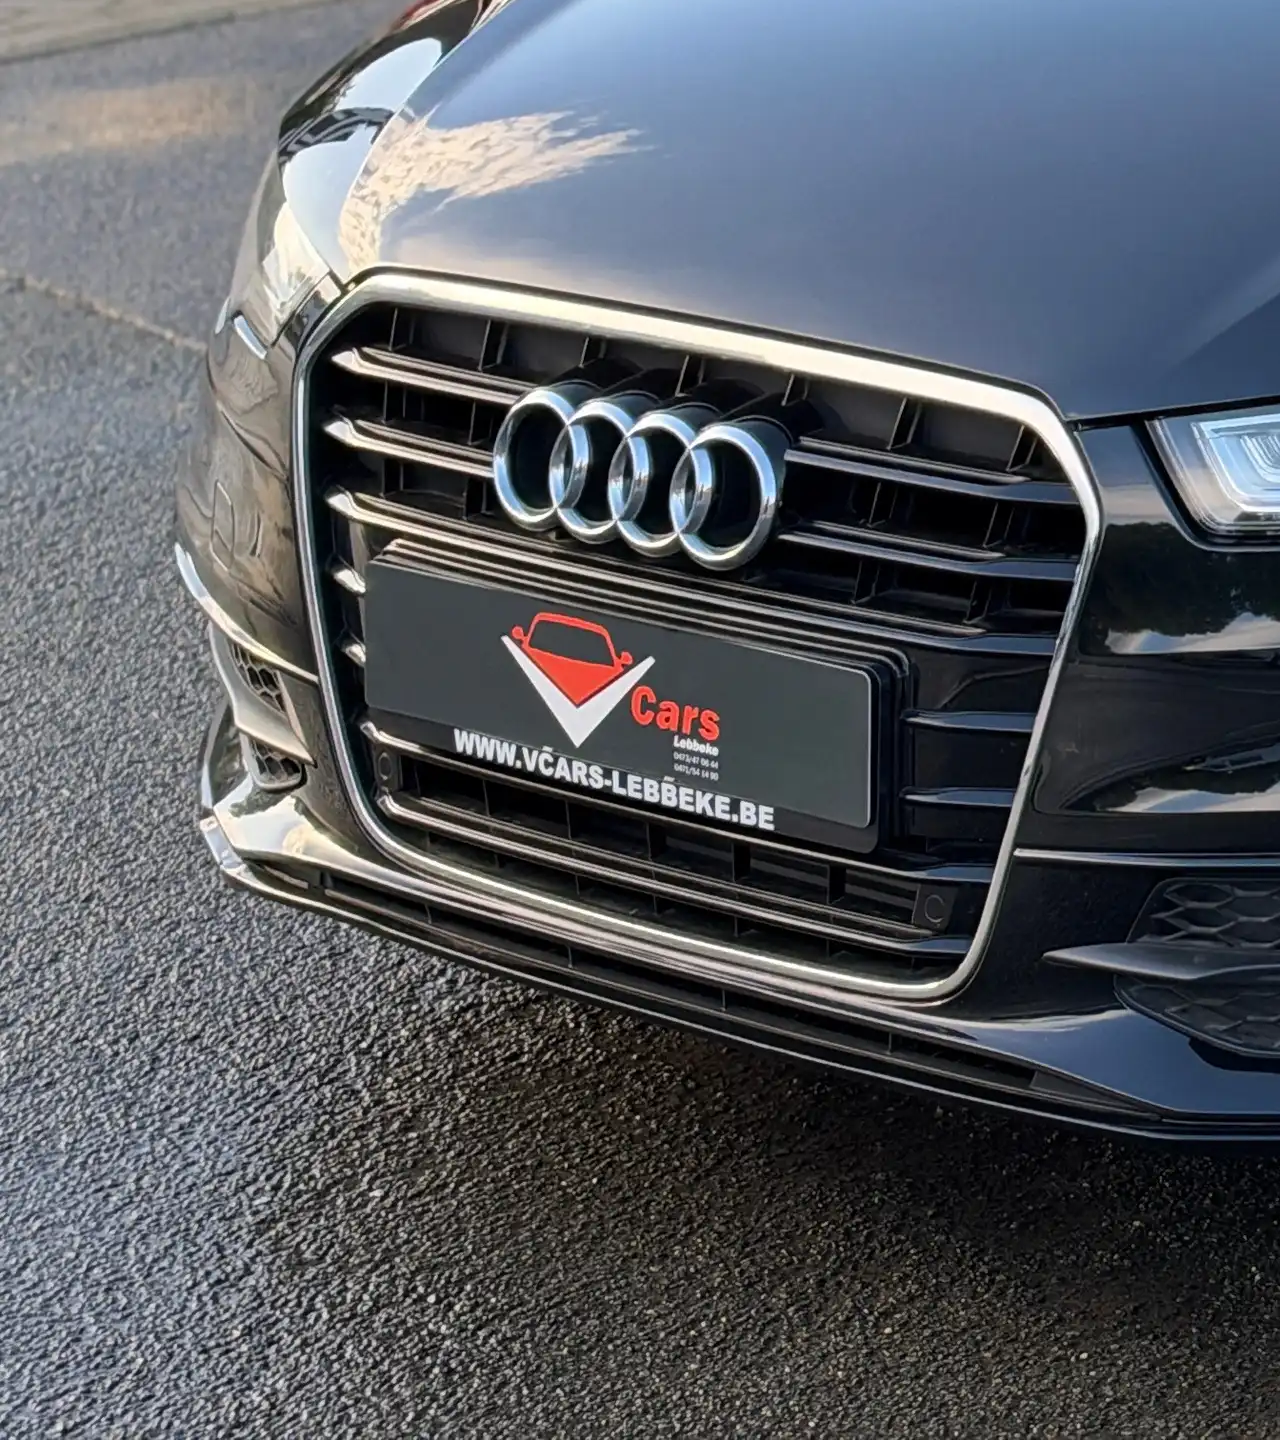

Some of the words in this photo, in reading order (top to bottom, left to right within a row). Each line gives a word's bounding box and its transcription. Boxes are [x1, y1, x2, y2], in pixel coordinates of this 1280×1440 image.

[630, 684, 720, 742] Cars
[673, 734, 719, 757] Lebbeke
[453, 727, 776, 832] WWW.VCARS-LEBBEKE.BE
